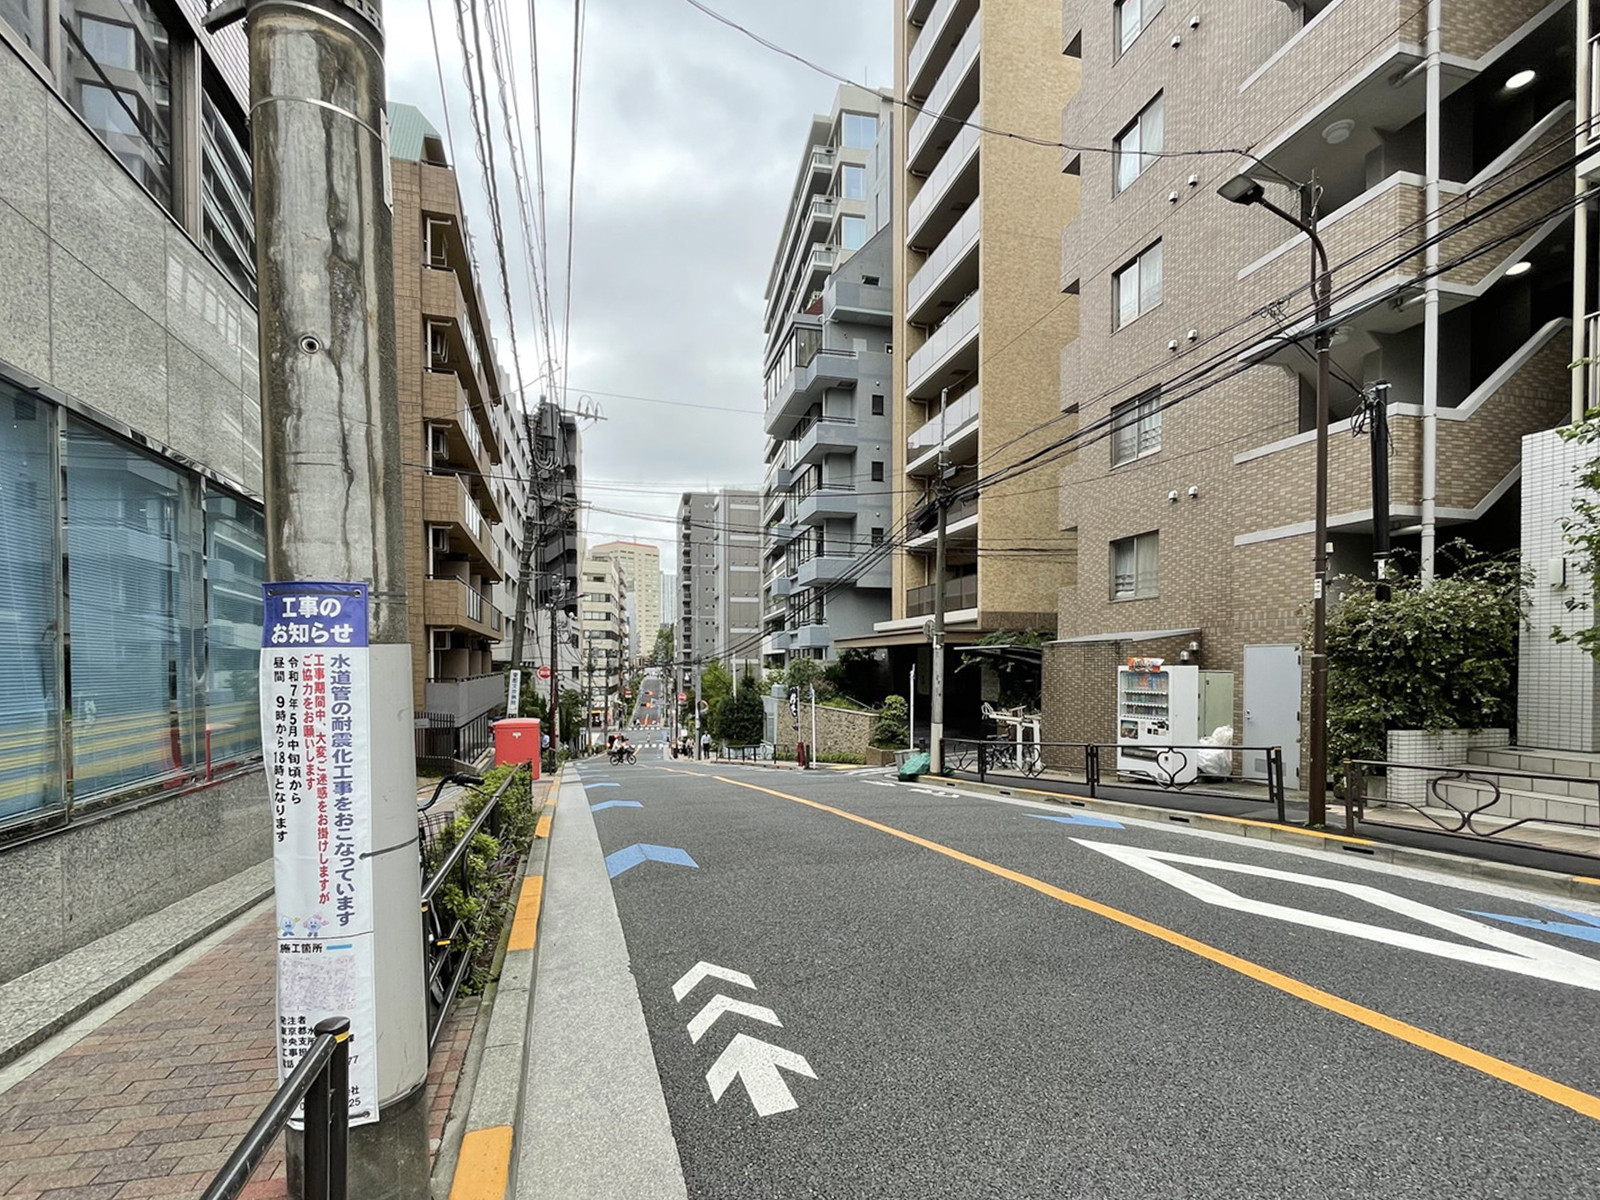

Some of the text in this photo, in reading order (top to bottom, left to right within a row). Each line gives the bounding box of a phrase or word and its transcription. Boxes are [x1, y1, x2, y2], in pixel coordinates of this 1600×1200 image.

[271, 622, 353, 643] お知らせ
[282, 597, 341, 618] 工事の
[273, 657, 288, 842] 昼間 9時から18時となります
[288, 656, 302, 804] 令和7年5月中旬頃から
[302, 653, 316, 790] ご協力をお願いします
[314, 654, 330, 904] 工事期間中、大変ご迷惑をお掛けしますが
[330, 653, 355, 926] 水道管の耐震化工事をおこなっています
[280, 943, 322, 954] 施工箇所
